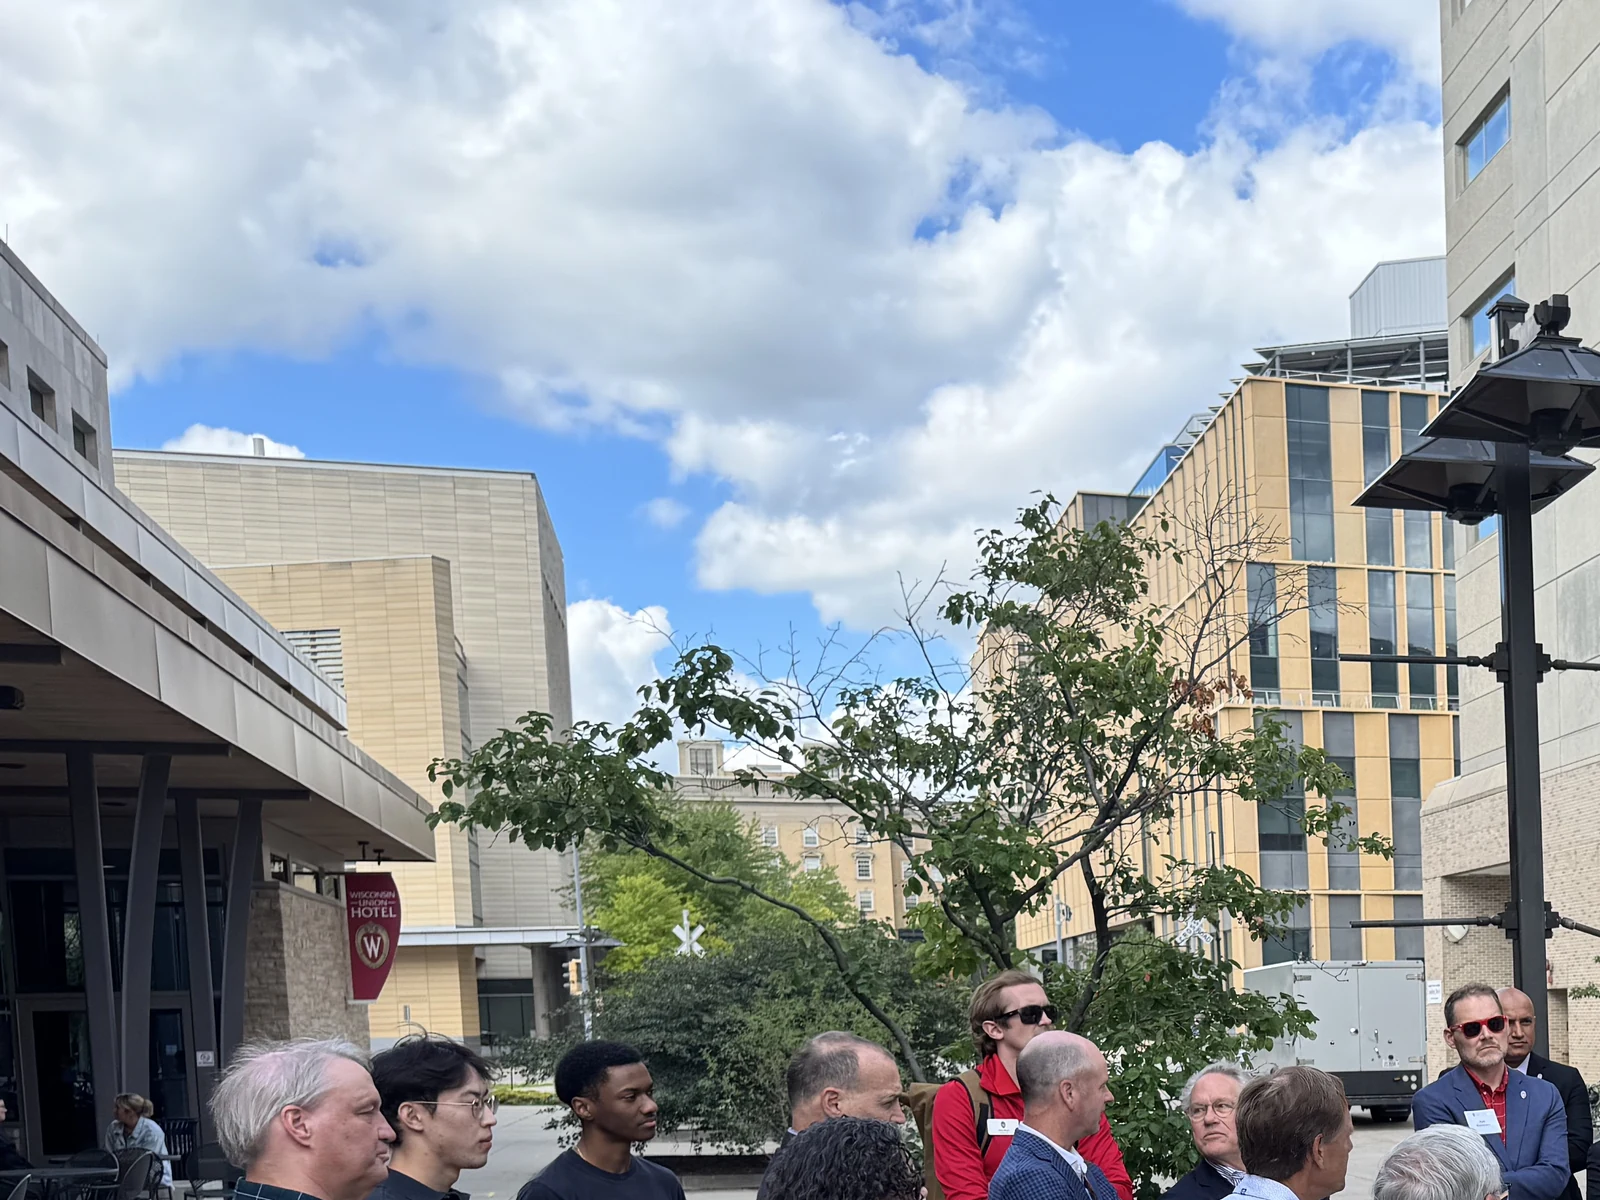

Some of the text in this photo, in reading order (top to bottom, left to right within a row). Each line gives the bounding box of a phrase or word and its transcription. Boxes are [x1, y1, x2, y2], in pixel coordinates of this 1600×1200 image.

[350, 891, 396, 899] WISCONSIN
[359, 899, 388, 907] UNION
[351, 907, 397, 918] HOTEL
[363, 935, 382, 959] W
